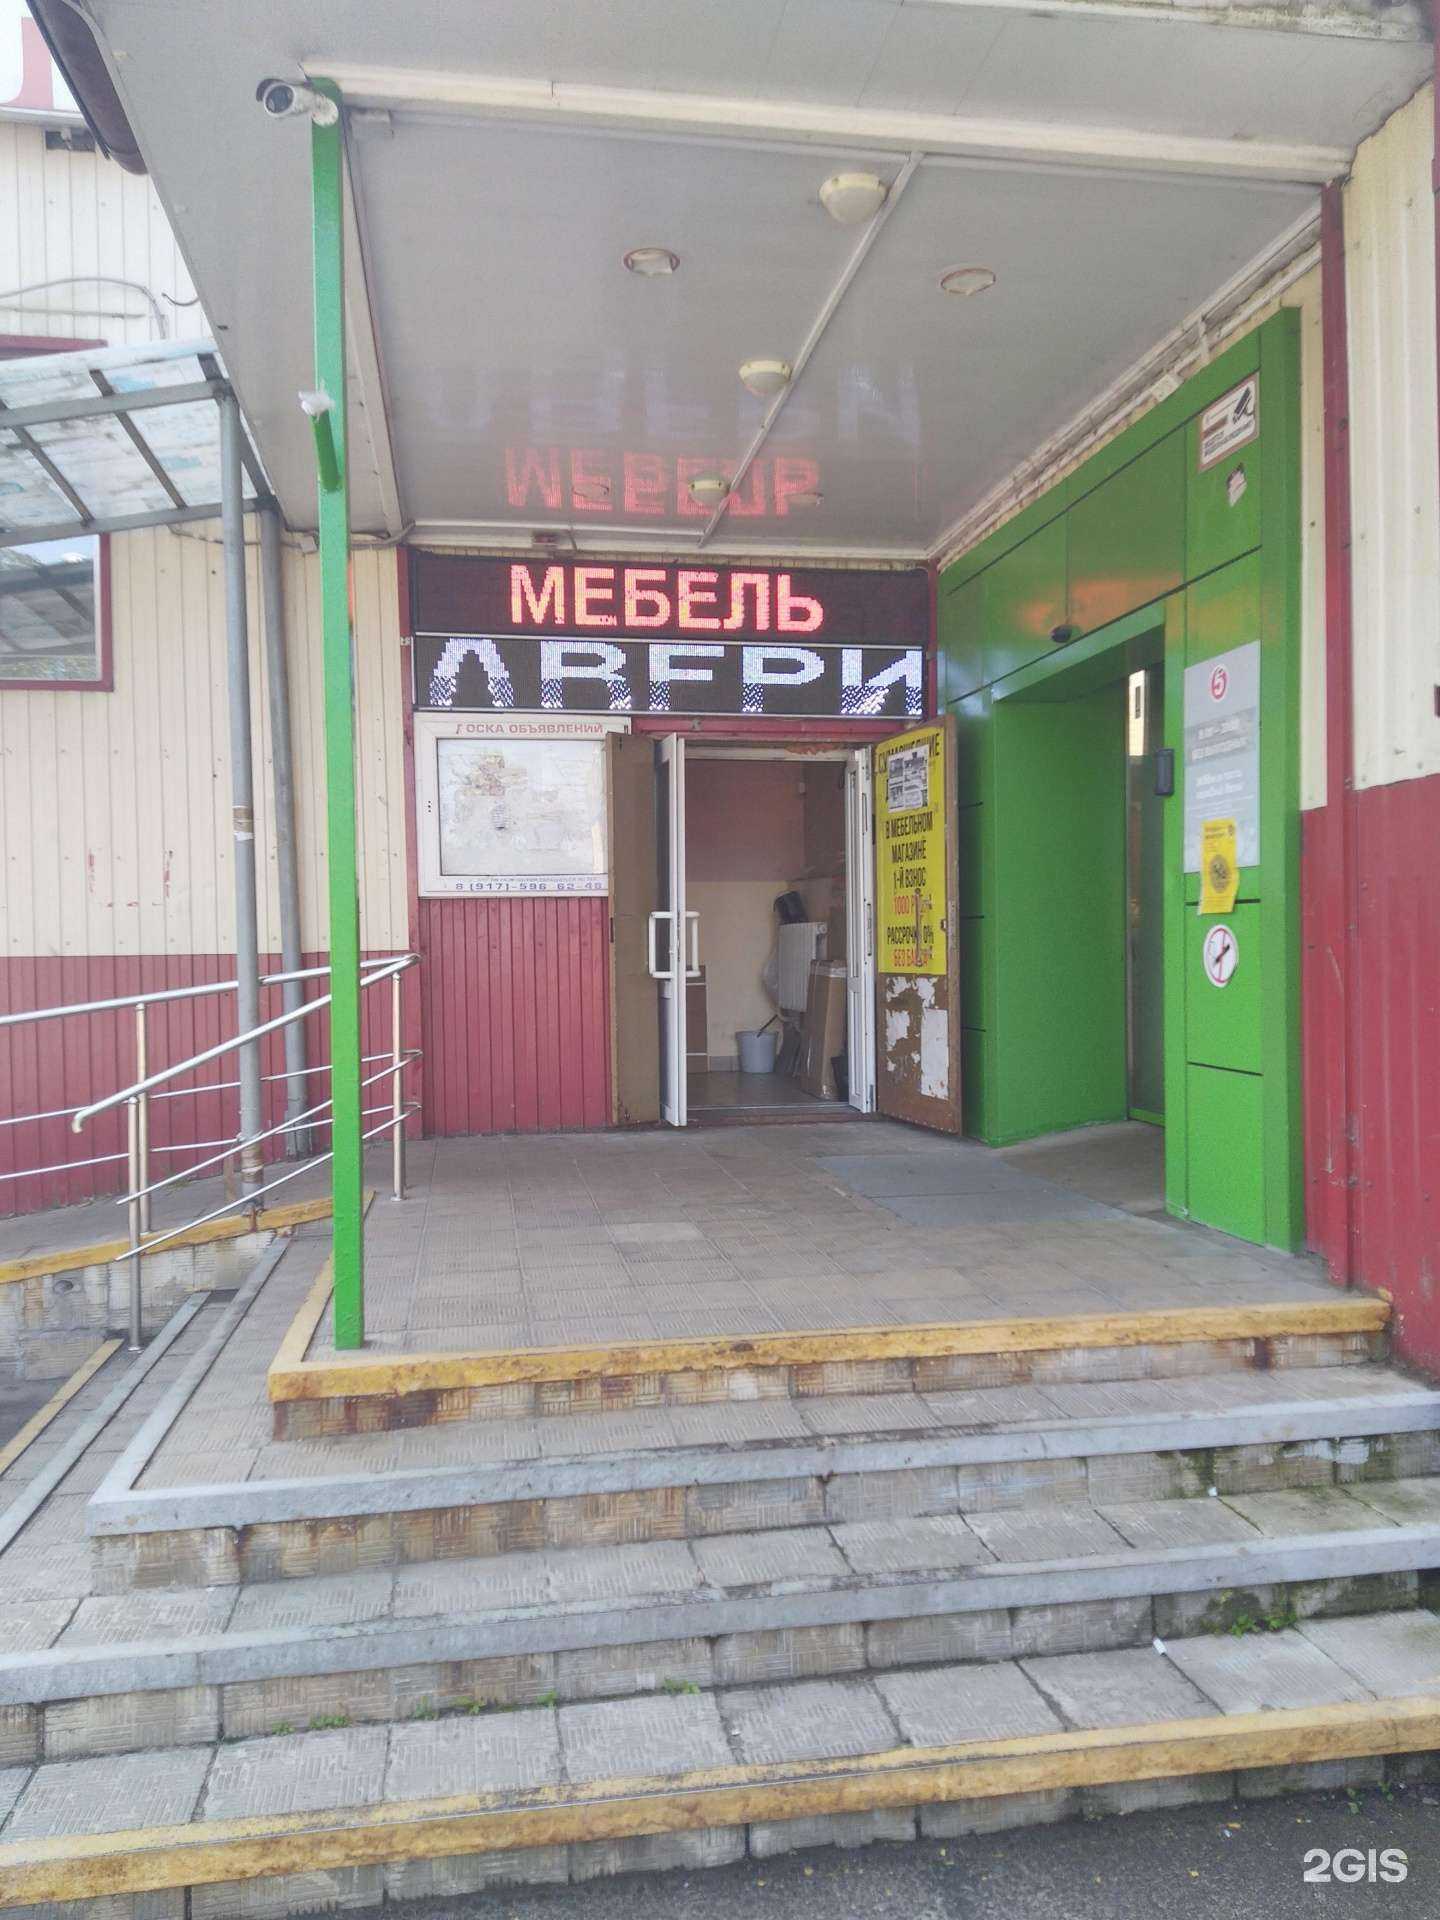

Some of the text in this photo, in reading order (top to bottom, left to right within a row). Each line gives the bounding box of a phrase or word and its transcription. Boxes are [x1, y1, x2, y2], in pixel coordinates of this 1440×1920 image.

[510, 564, 824, 632] МЕБЕЛЬ
[508, 723, 604, 734] ОБЪЯВЛЕНИЙ
[891, 811, 933, 838] МЕБЕЛЬНОМ
[892, 840, 927, 863] МАГАЗИНЕ
[905, 867, 926, 888] ВЗНОС
